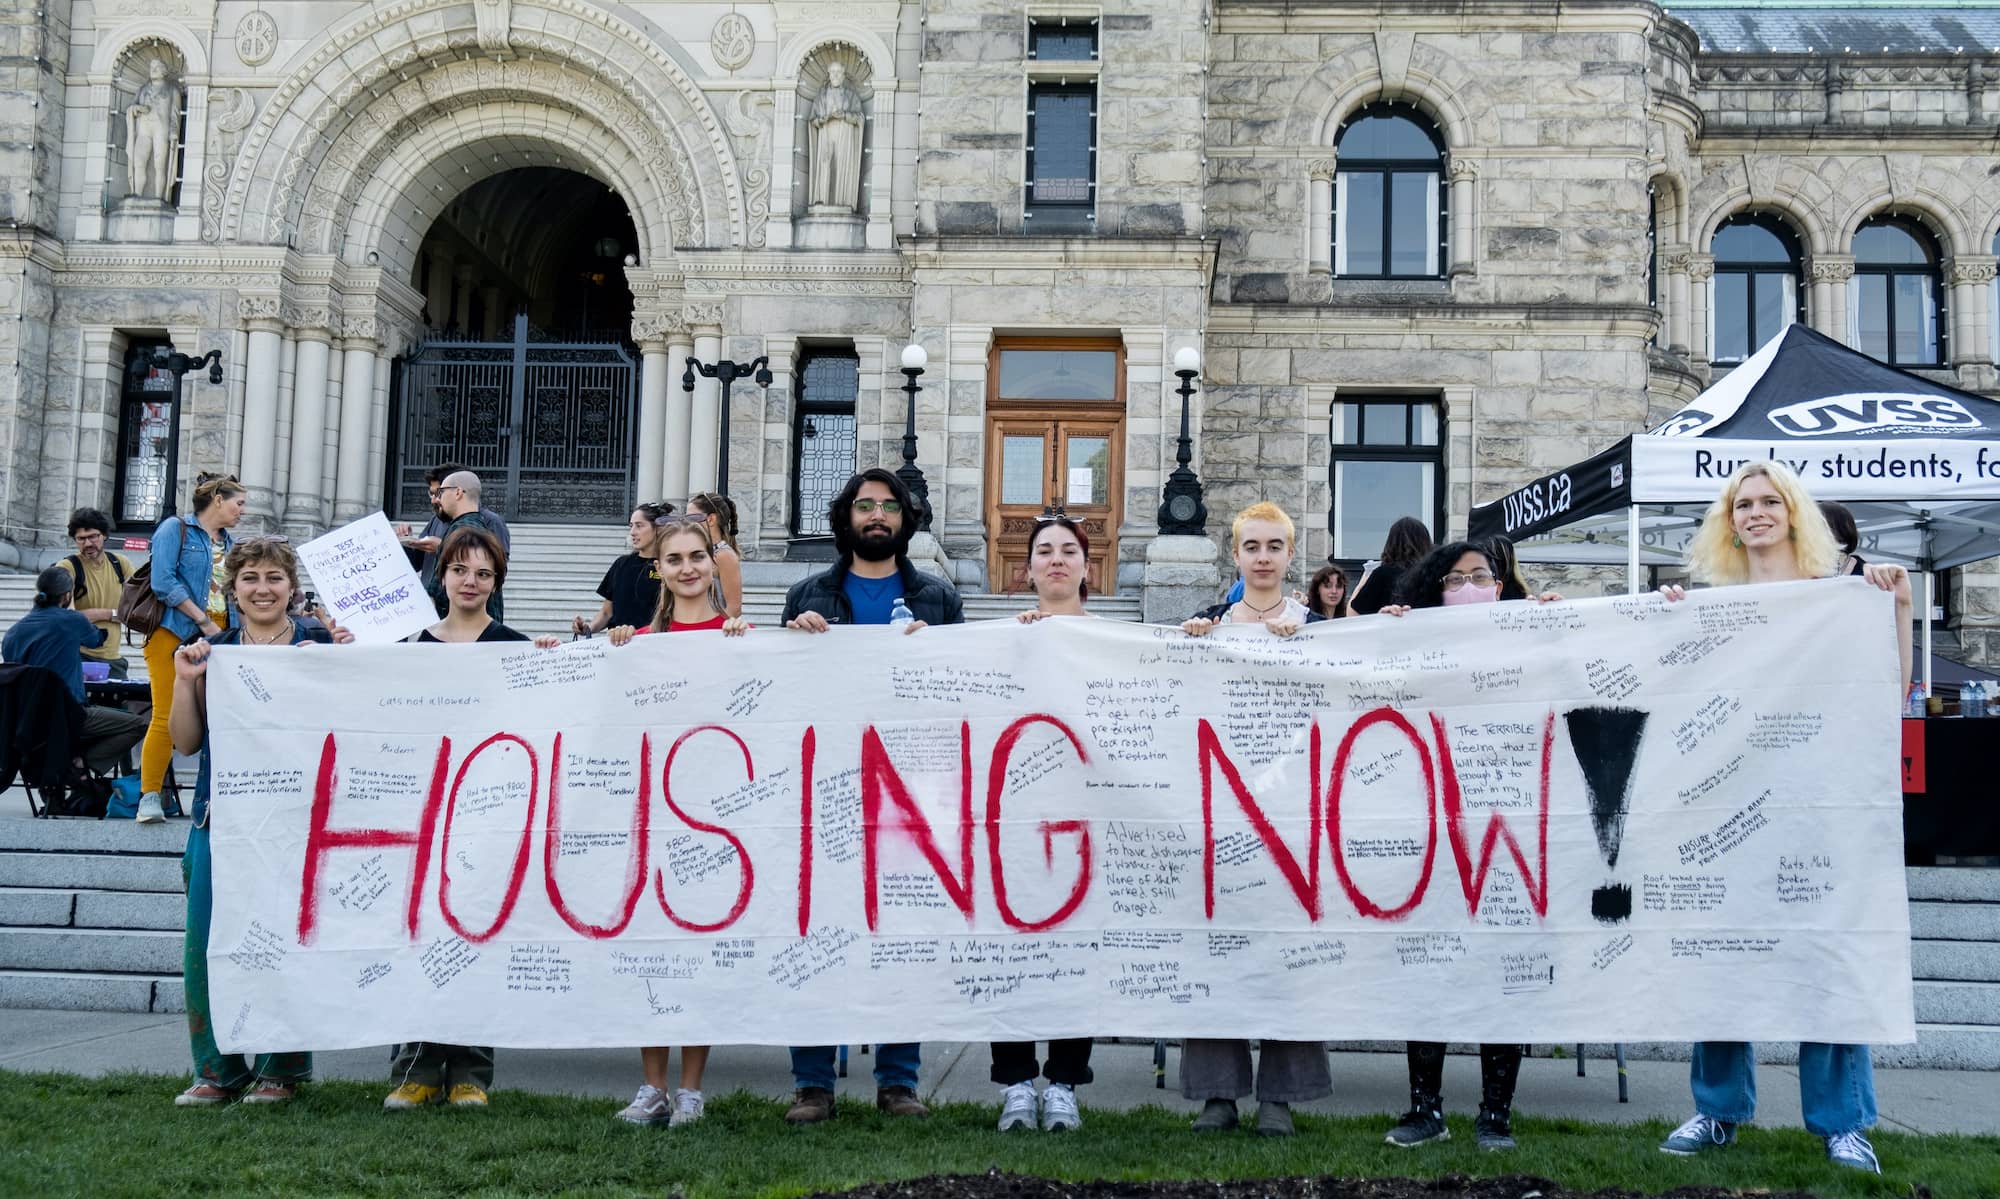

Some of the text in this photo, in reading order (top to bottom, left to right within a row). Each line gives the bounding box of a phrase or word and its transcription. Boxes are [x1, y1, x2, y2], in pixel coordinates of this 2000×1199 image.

[1774, 400, 1973, 432] UVSS
[1822, 448, 1962, 483] students,
[1503, 473, 1572, 533] UVSS.ca
[334, 538, 354, 551] TEST
[334, 585, 381, 611] HELPLESS
[1504, 665, 1523, 676] load
[660, 679, 689, 690] closet
[1119, 678, 1138, 689] not
[1141, 678, 1159, 688] call
[1167, 679, 1183, 688] an
[1486, 677, 1519, 690] laundry
[406, 697, 423, 705] not
[652, 690, 678, 704] $600
[1140, 709, 1156, 719] rid
[1165, 705, 1180, 718] of
[1455, 723, 1535, 737] The TERRIBLE
[1455, 742, 1537, 760] feeling that I
[586, 758, 608, 766] decide
[1476, 759, 1509, 767] NEVER
[1511, 757, 1533, 767] have
[586, 768, 617, 778] boyfriend
[1350, 760, 1378, 778] Never
[1362, 772, 1384, 785] back
[1458, 770, 1491, 787] enough
[1508, 770, 1522, 778] to
[1463, 785, 1521, 799] rent in my
[297, 713, 1090, 945] HOUSING
[1106, 821, 1186, 842] Advertised
[666, 835, 691, 850] $800
[1678, 833, 1710, 855] ENSURE
[1106, 843, 1119, 855] to
[1122, 844, 1148, 857] have
[1107, 873, 1134, 885] None
[1139, 873, 1150, 884] of
[1491, 867, 1515, 884] They
[1777, 873, 1810, 884] Broken
[1151, 886, 1175, 899] Still
[1484, 895, 1504, 904] care
[510, 944, 560, 954] Landlord lied
[715, 940, 731, 948] HAD
[731, 940, 740, 948] TO
[950, 941, 957, 952] A
[965, 940, 1005, 953] Mystery
[643, 953, 666, 964] rent
[672, 953, 681, 964] if
[685, 957, 704, 967] you
[712, 950, 755, 959] MY LANDLORD
[1501, 953, 1549, 963] stuck with
[612, 965, 637, 975] send
[638, 965, 669, 975] naked
[1131, 961, 1157, 973] have
[1157, 960, 1180, 972] the
[564, 974, 570, 982] 3
[1110, 974, 1178, 995] right of quiet
[1129, 983, 1210, 999] enjoyment of my
[1169, 993, 1192, 1001] home
